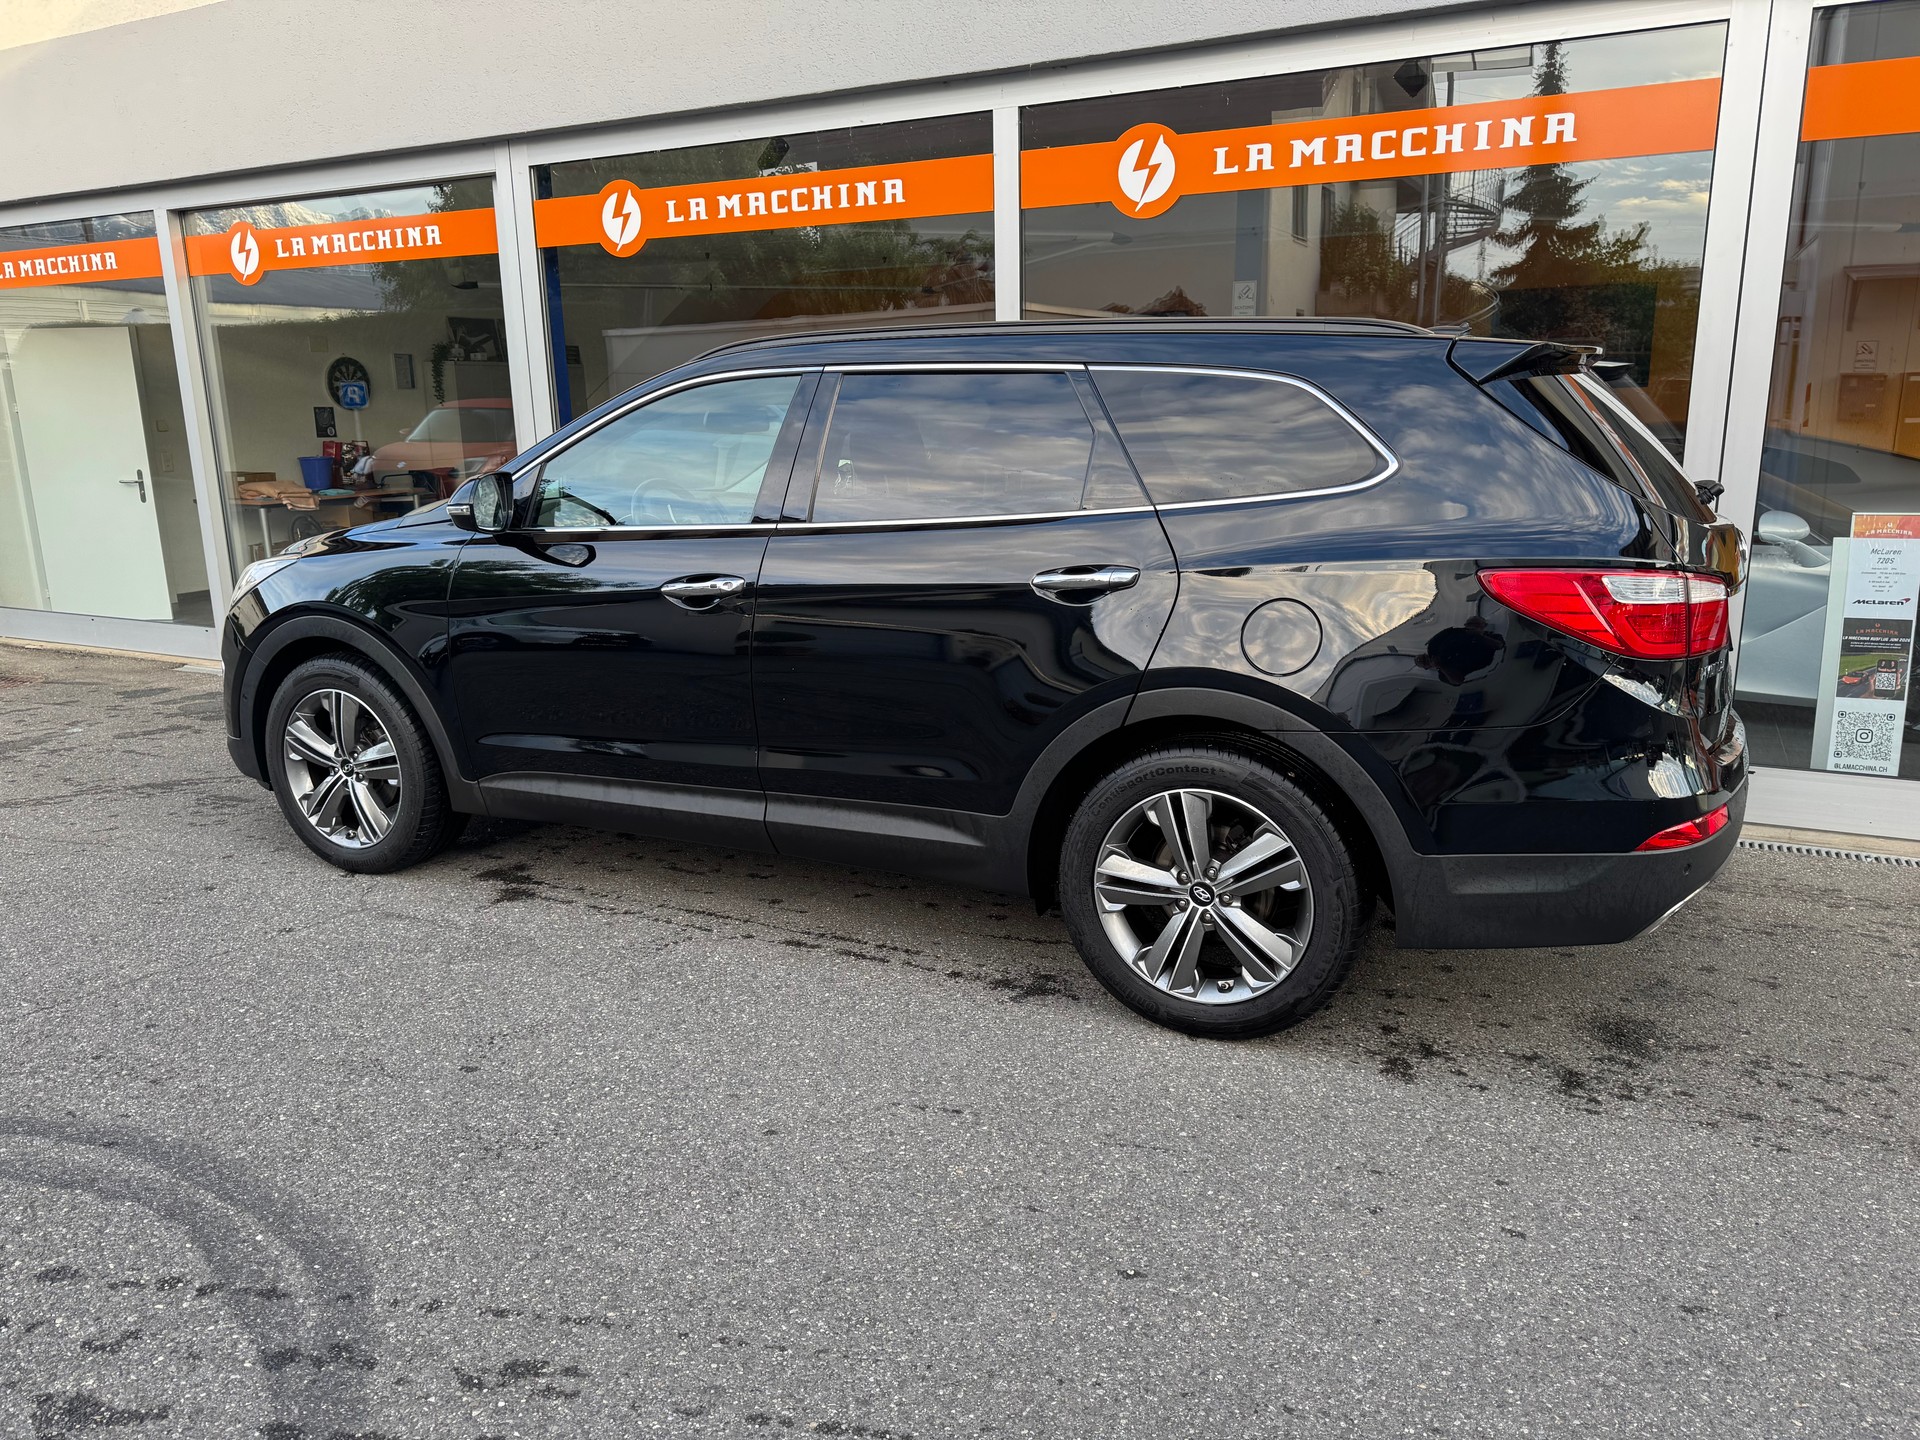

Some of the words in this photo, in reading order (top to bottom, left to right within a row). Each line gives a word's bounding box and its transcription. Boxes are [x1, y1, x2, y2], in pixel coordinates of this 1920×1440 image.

[1214, 143, 1274, 174] LA
[1289, 112, 1577, 167] MACCHINA
[666, 198, 708, 222] LA
[717, 179, 905, 218] MACCHINA
[275, 238, 306, 257] LA
[311, 225, 441, 254] MACCHINA
[0, 261, 16, 278] A
[18, 252, 117, 277] MACCHINA
[1834, 763, 1888, 772] @LAMACCHINA.CH
